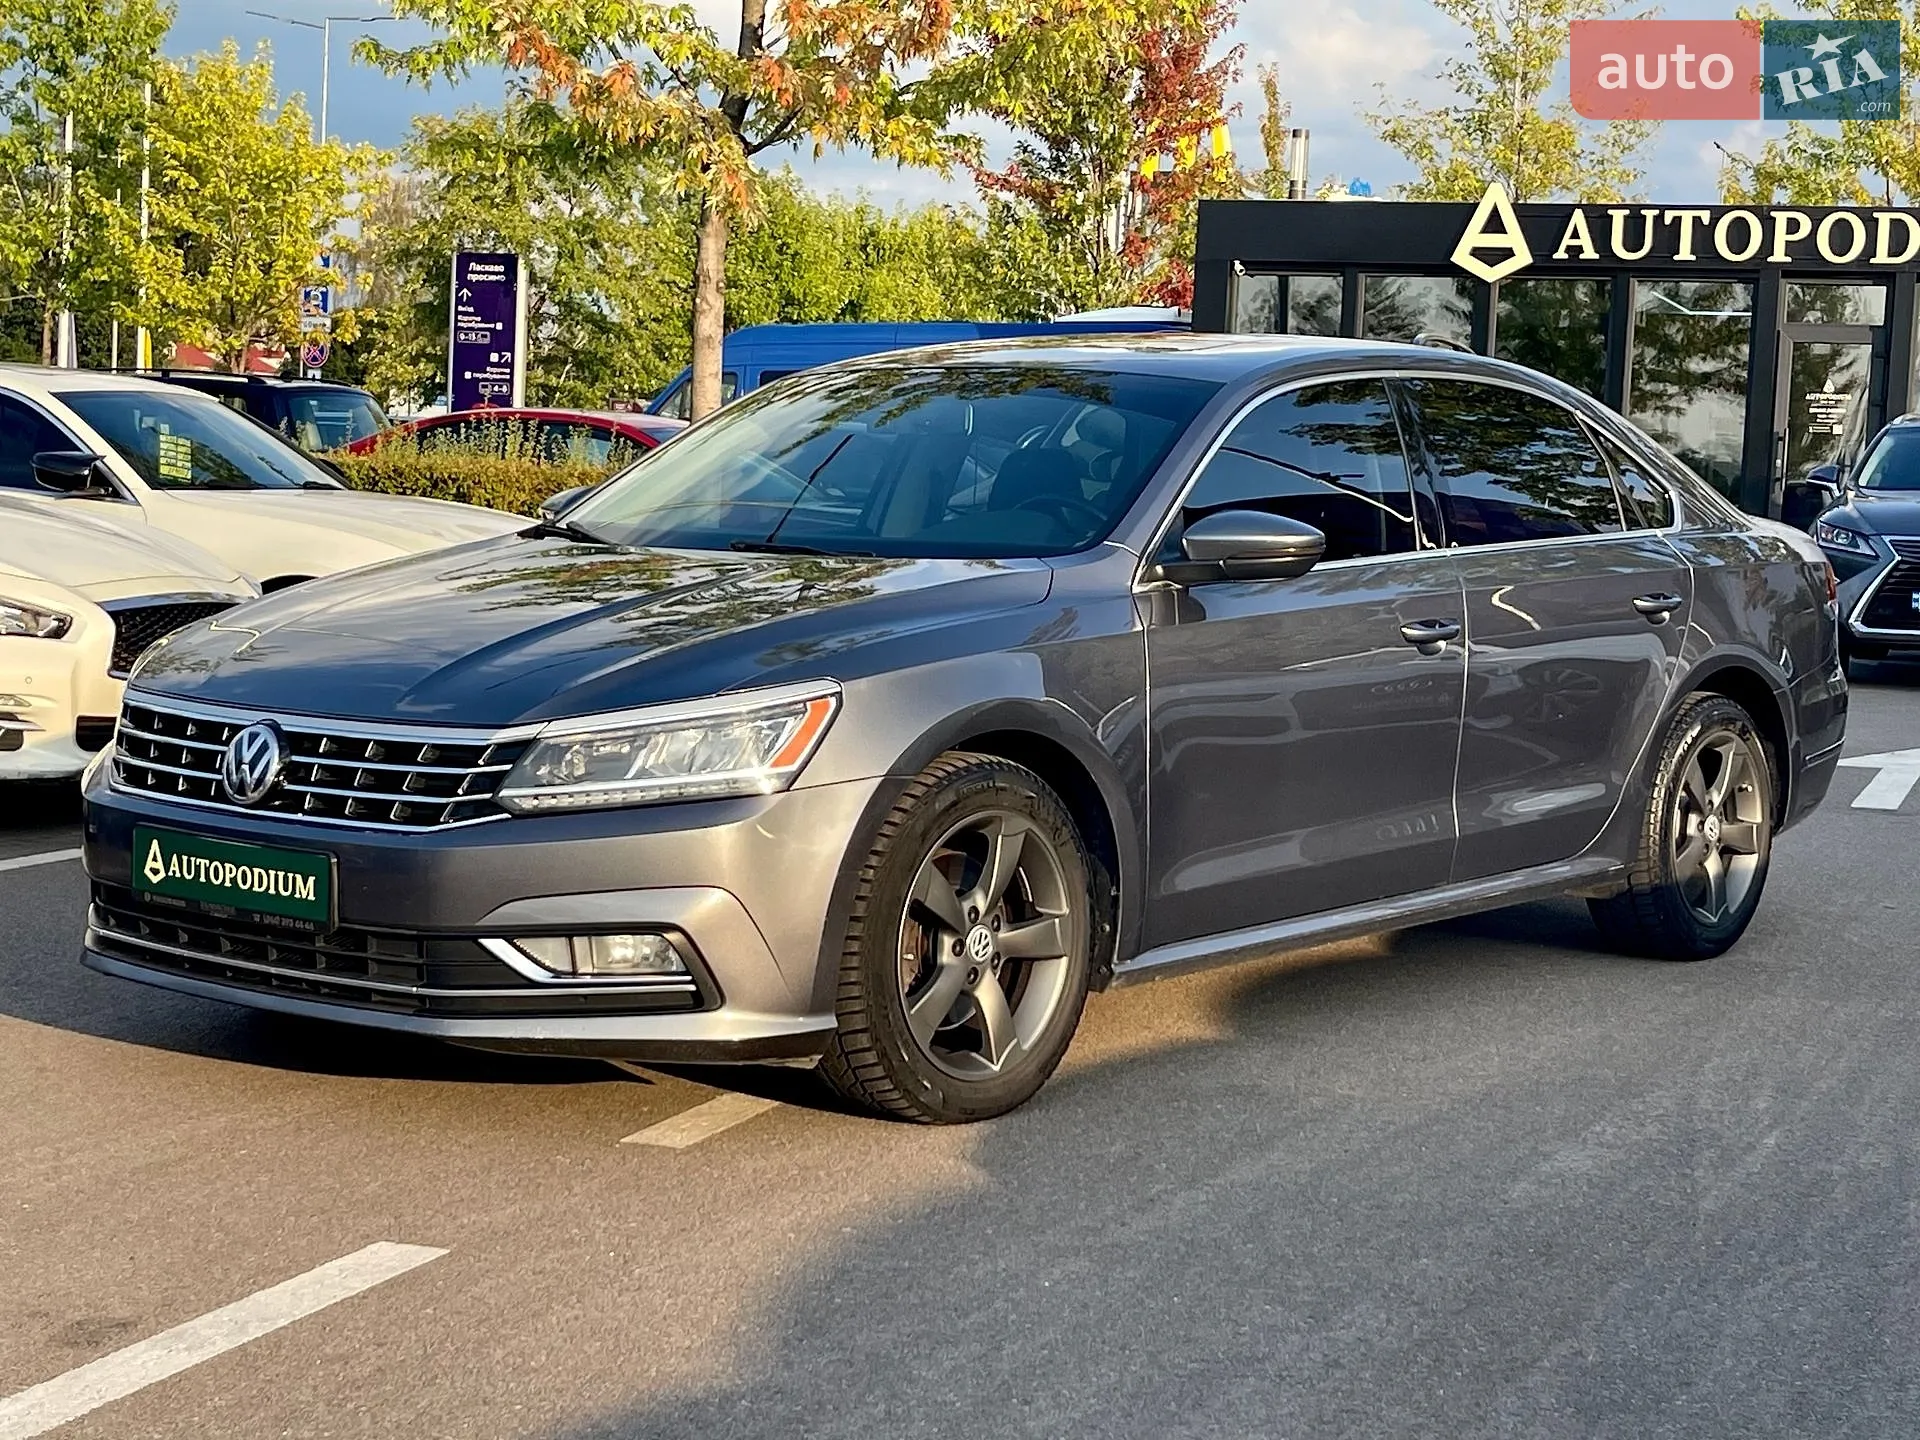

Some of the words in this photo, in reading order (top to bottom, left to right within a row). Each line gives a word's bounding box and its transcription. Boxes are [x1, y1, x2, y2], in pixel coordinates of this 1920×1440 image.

[1552, 207, 1920, 265] AUTOPOD
[466, 273, 506, 283] просимо
[468, 261, 505, 272] Ласкаво
[167, 852, 316, 902] AUTOPODIUM
